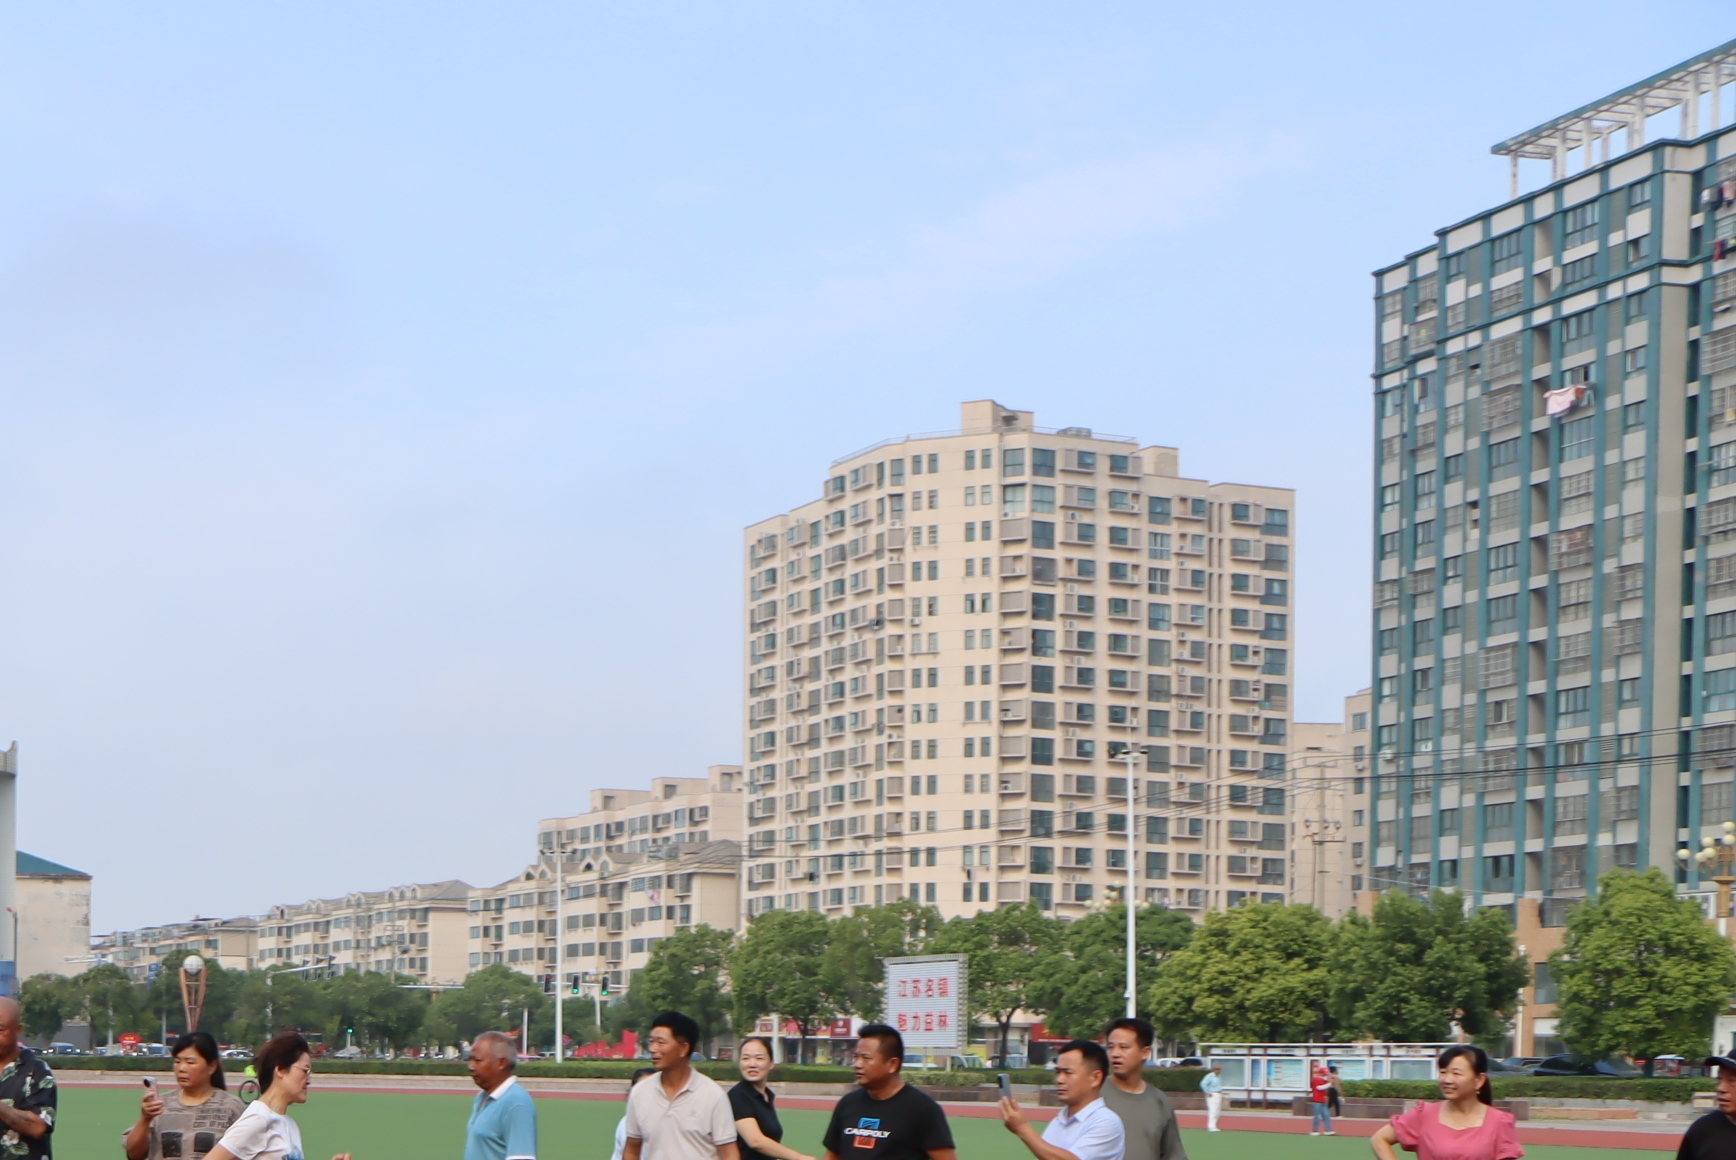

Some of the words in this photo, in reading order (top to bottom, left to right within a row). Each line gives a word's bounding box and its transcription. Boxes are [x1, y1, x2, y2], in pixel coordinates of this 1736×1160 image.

[898, 977, 949, 998] 江苏名镇
[898, 1011, 949, 1032] 魅力益林
[844, 1127, 891, 1138] CARPOLY
